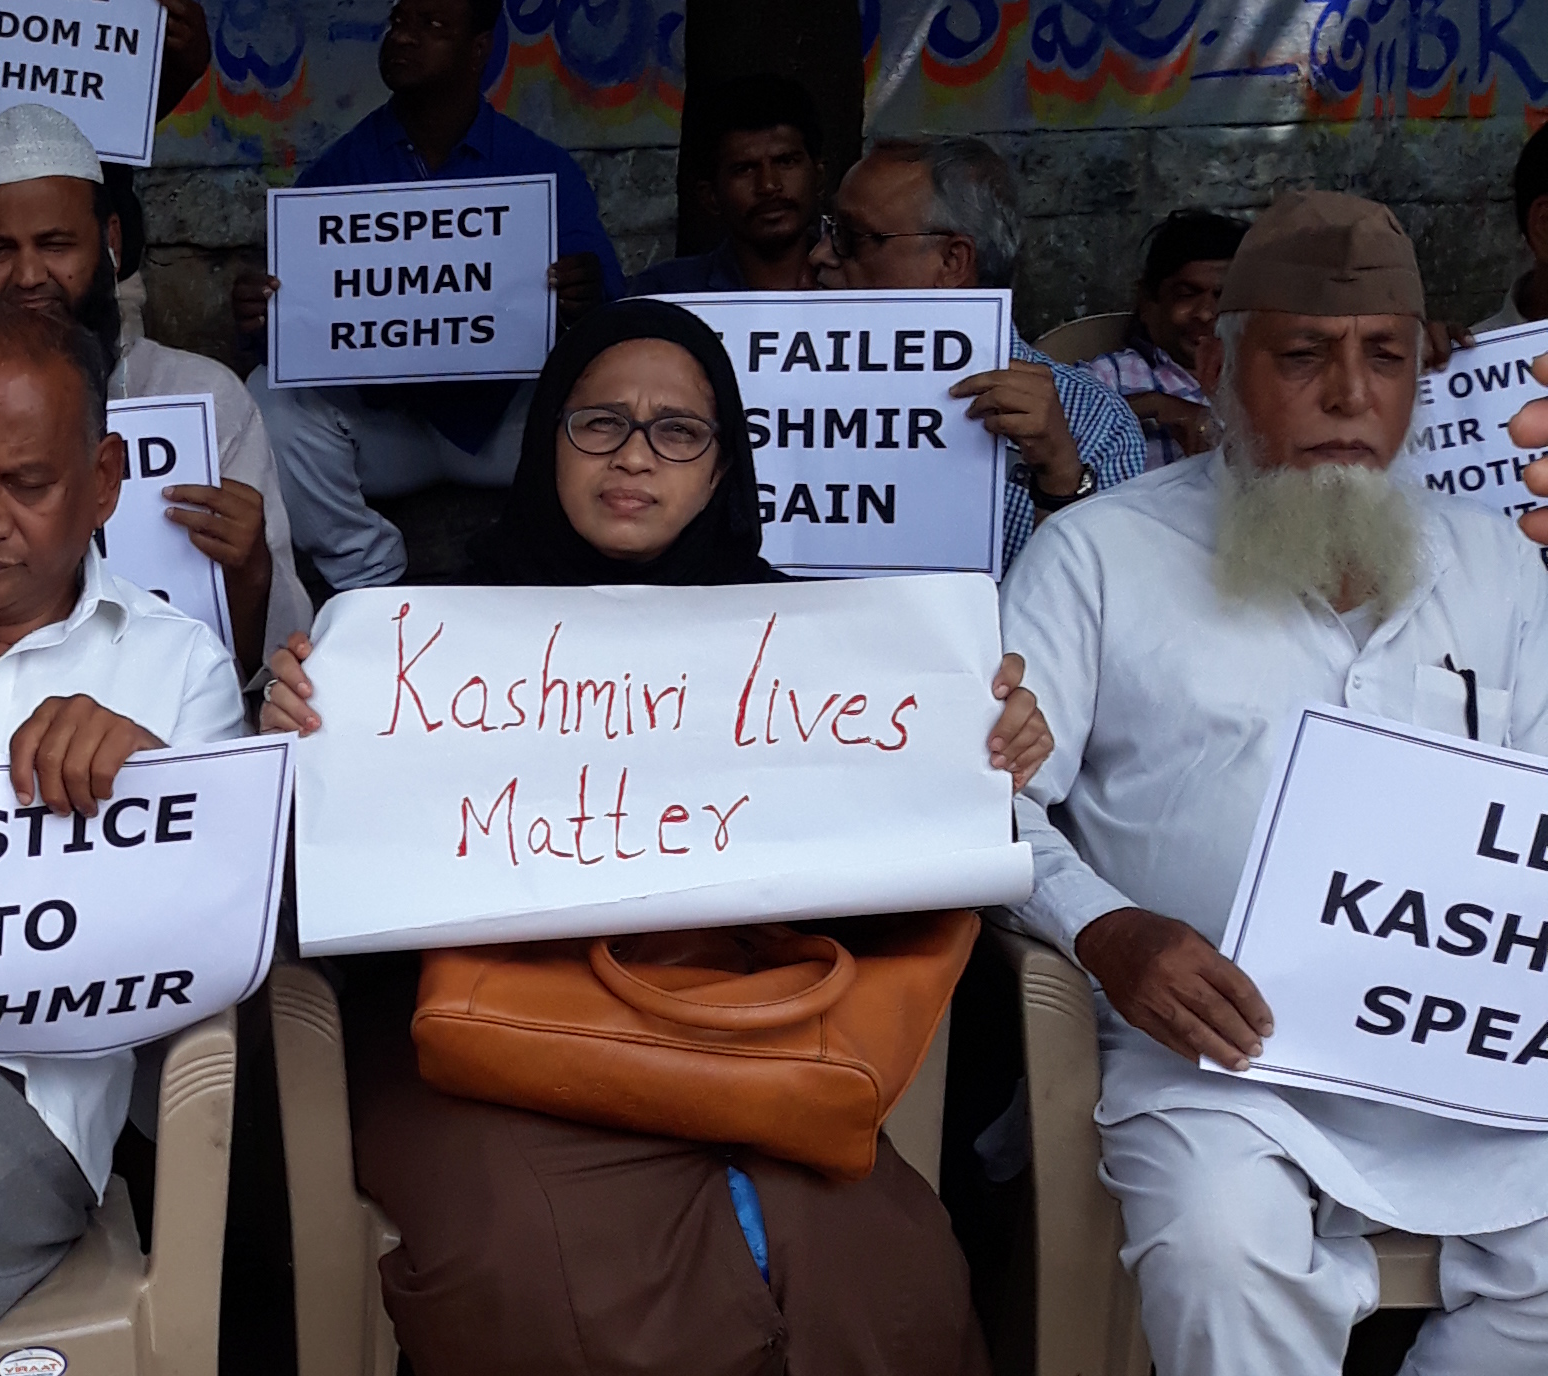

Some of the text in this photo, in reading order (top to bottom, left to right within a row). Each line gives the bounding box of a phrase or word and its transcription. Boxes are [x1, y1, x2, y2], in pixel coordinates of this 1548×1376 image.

[93, 23, 139, 56] IN
[318, 205, 510, 245] RESPECT
[333, 261, 493, 299] HUMAN
[330, 314, 496, 351] RIGHTS
[748, 329, 974, 373] FAILED
[377, 601, 690, 738] Kashmiri
[455, 764, 751, 867] Matter
